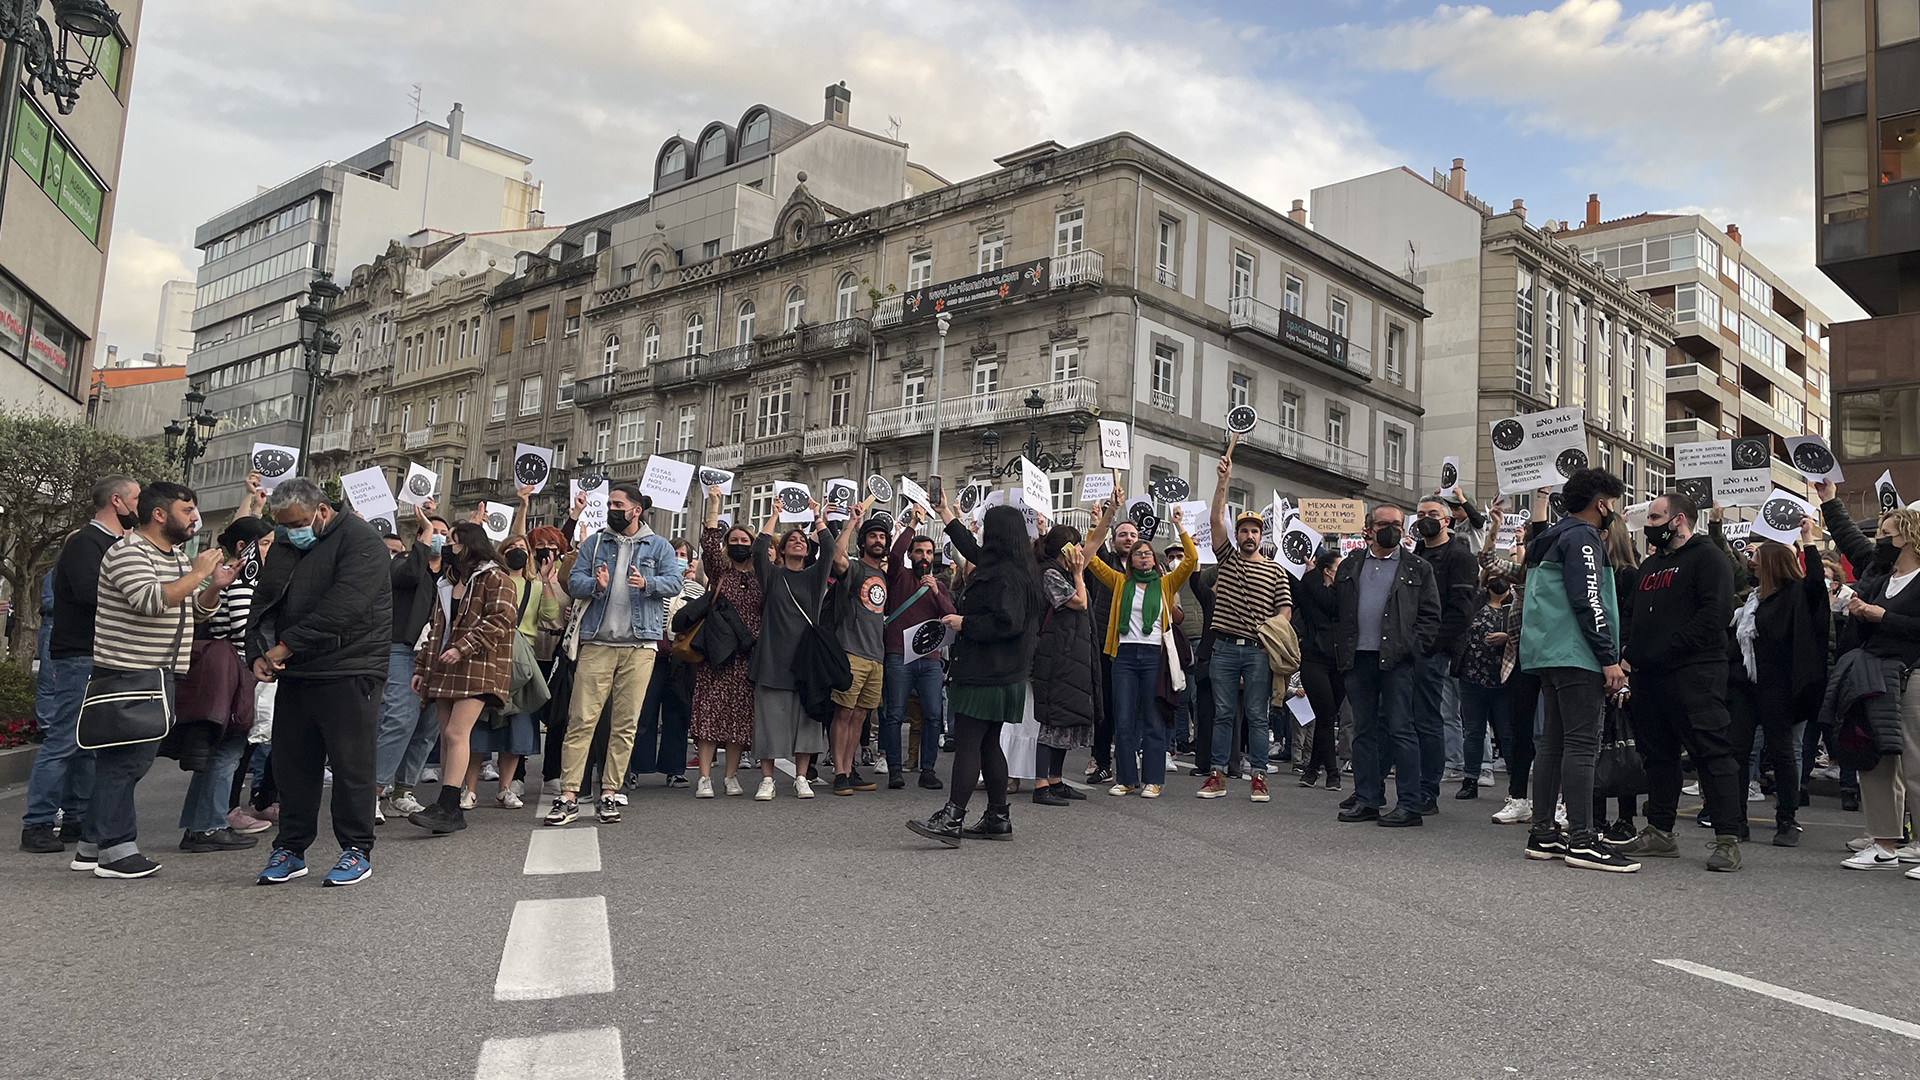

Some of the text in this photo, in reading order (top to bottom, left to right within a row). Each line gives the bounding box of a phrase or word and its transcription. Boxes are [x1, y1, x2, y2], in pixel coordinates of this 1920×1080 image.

[1108, 429, 1120, 437] NO
[1108, 440, 1122, 448] WE
[1494, 435, 1522, 450] AUTONOMA
[1104, 450, 1127, 459] CAN'T
[1571, 450, 1587, 465] LUCHA
[530, 455, 546, 471] LUCHA
[1500, 459, 1523, 467] CREAMOS
[1504, 464, 1523, 472] PROPIO
[1795, 454, 1831, 473] AUTONOMA
[516, 461, 539, 484] AUTONOMA
[651, 467, 672, 476] ESTAS
[1030, 471, 1042, 482] NO
[1511, 469, 1540, 477] MERECEMOS
[650, 473, 676, 483] CUOTAS
[1164, 477, 1187, 488] LUCHA
[350, 481, 368, 490] ESTAS
[352, 485, 376, 495] CUOTAS
[646, 483, 681, 496] EXPLOTAN
[1030, 480, 1044, 493] WE
[356, 493, 387, 505] EXPLOTAN
[1026, 486, 1049, 505] CAN'T
[1154, 486, 1185, 502] AUTONOMA
[586, 500, 601, 508] NO
[834, 498, 847, 508] 24
[1764, 501, 1791, 530] AUTONOMA
[578, 520, 607, 529] CAN'
[1300, 533, 1312, 554] LUCHA
[1581, 545, 1596, 571] OFF
[914, 624, 928, 646] LUCHA
